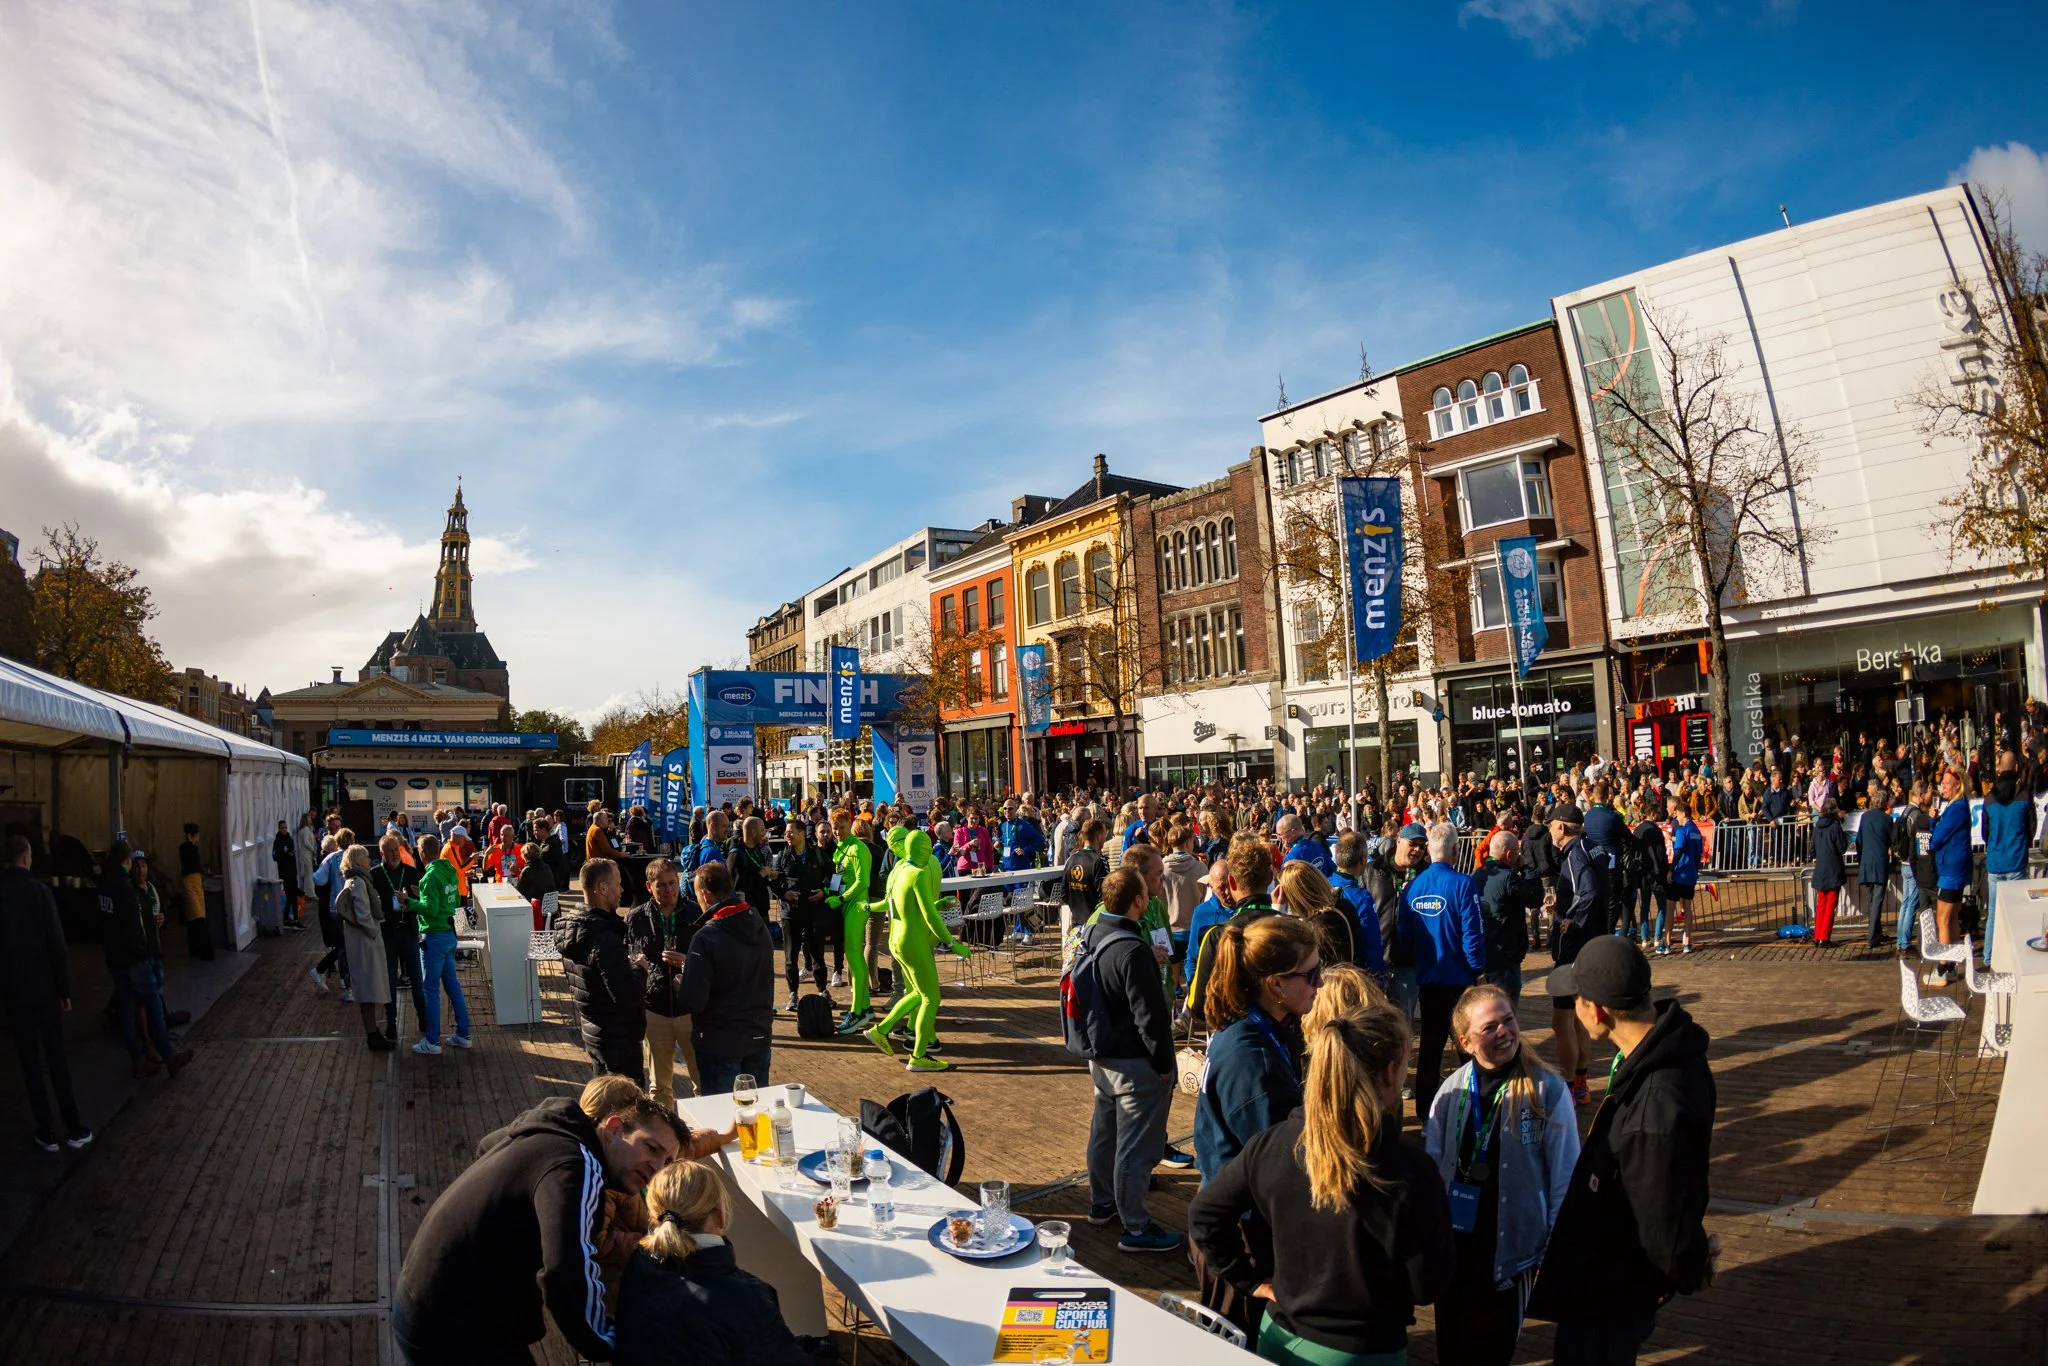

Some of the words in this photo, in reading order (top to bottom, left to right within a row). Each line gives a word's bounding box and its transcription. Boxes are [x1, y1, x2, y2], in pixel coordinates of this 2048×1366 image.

[1355, 507, 1393, 629] menzis
[1514, 589, 1532, 667] GRONINGEN
[1526, 631, 1538, 658] VAN
[1856, 640, 1942, 672] Bershka
[724, 691, 751, 701] menzis
[775, 678, 878, 704] FINH
[837, 661, 856, 724] menzis
[1308, 701, 1345, 716] GUTS
[1359, 695, 1411, 712] GUTO
[1472, 698, 1571, 720] blue-tomato
[1745, 672, 1765, 755] Bershka
[371, 733, 409, 743] MENZIS
[411, 734, 418, 743] 4
[418, 734, 442, 743] MIJL
[444, 735, 464, 744] VAN
[465, 736, 521, 745] GRONINGEN
[628, 759, 649, 807] enzis
[717, 770, 747, 778] Boels
[663, 763, 684, 832] menzis
[907, 790, 931, 799] STOX
[1415, 899, 1441, 910] menzis
[1055, 1320, 1107, 1328] CULTUUR
[1057, 1310, 1095, 1319] SPORT
[1096, 1310, 1106, 1319] &
